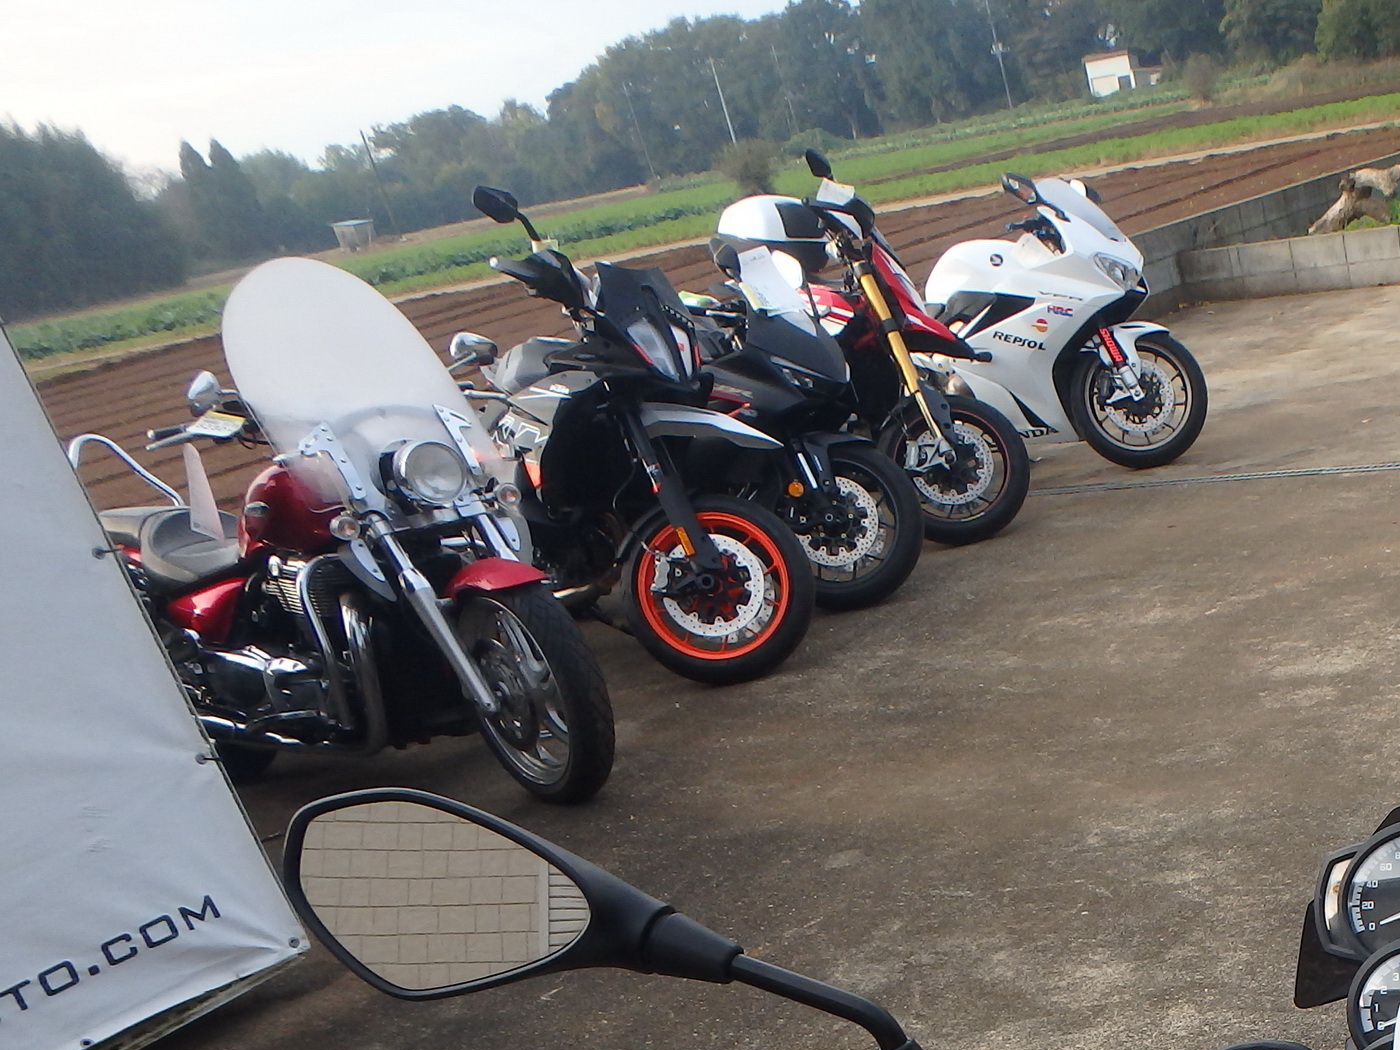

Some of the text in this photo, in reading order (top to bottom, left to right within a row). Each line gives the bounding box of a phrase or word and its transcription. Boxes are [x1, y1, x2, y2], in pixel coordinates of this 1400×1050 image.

[1047, 305, 1073, 317] HRC
[992, 331, 1046, 350] REPSOL
[1100, 328, 1124, 362] SHOWA
[1019, 427, 1058, 438] NDA
[1379, 862, 1393, 871] 60
[1366, 880, 1379, 889] 40
[1361, 901, 1375, 910] 20
[1368, 922, 1376, 931] 0
[0, 895, 220, 1012] TO.COM
[1392, 973, 1399, 981] 3
[1380, 986, 1388, 995] 2
[1374, 1003, 1379, 1013] 1
